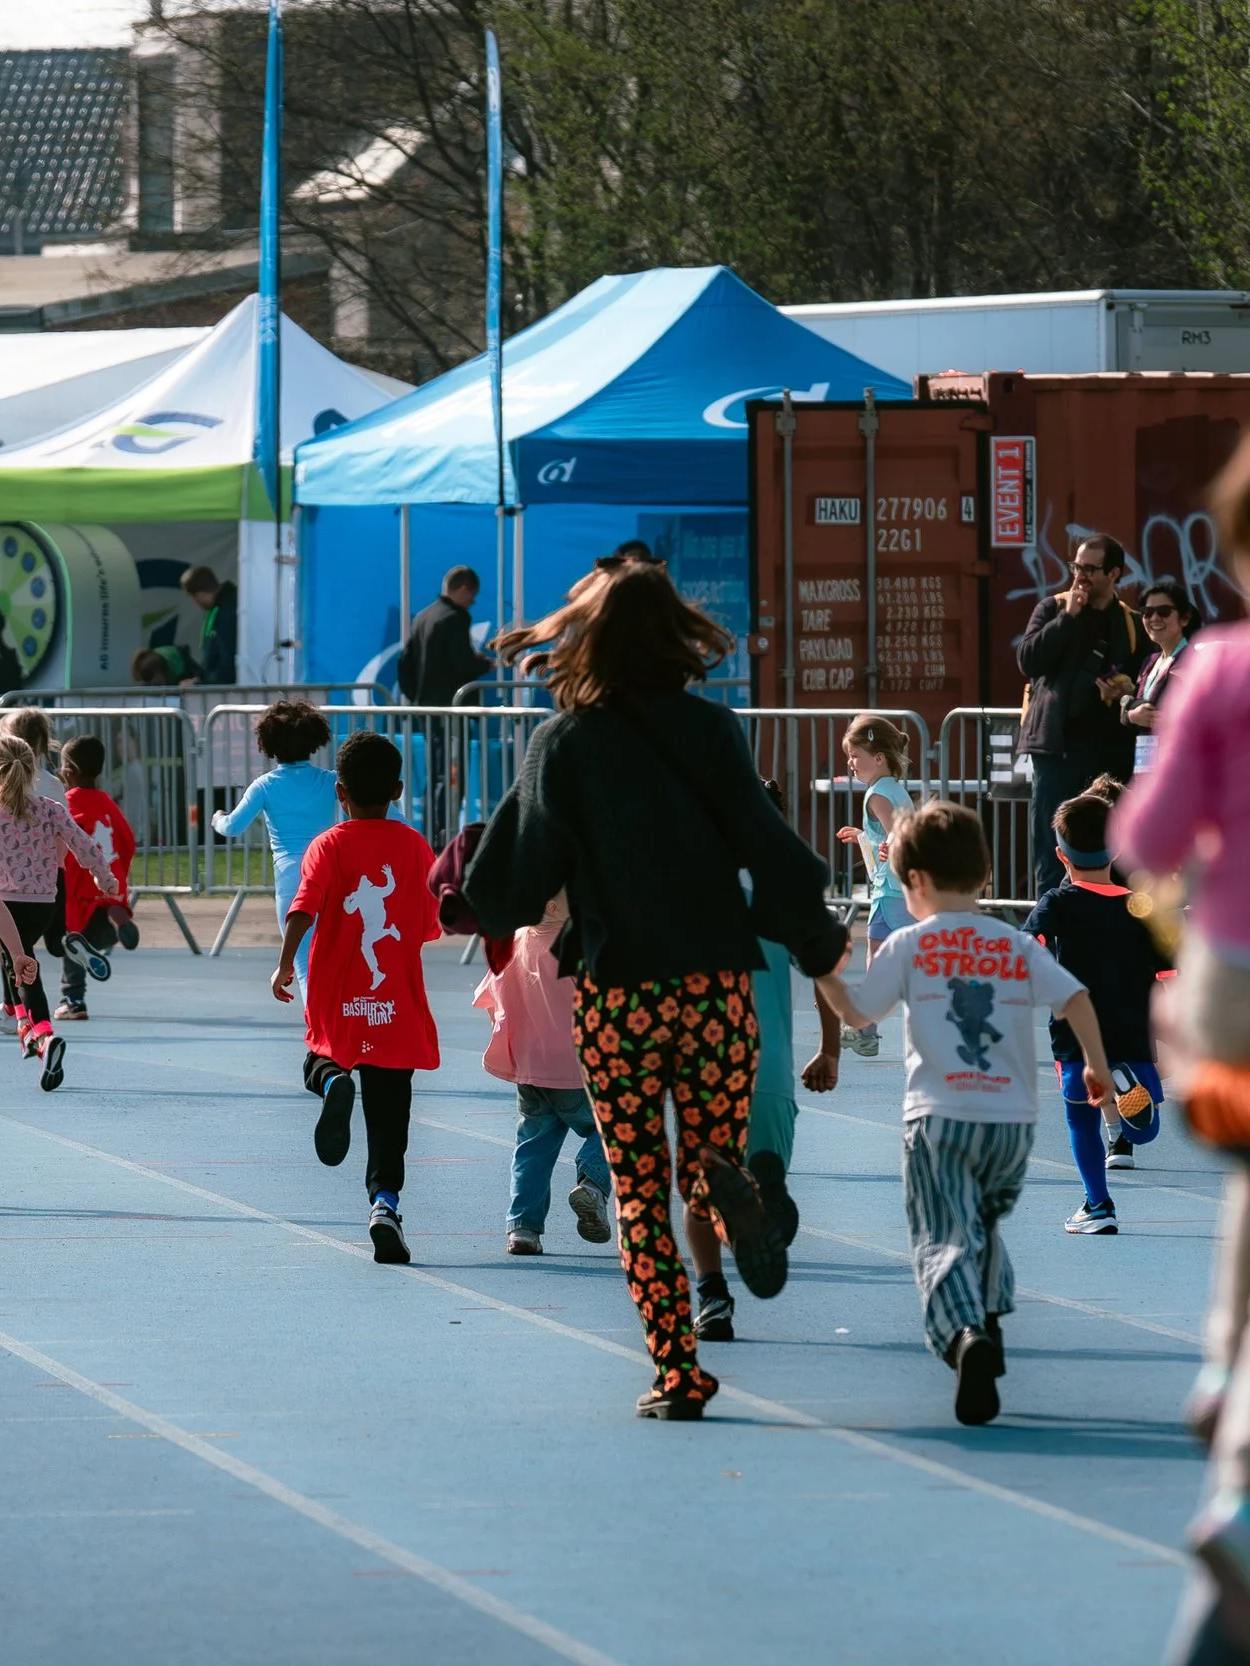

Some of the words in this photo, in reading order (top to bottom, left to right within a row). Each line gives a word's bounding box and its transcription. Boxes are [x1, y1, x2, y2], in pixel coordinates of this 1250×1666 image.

[1181, 330, 1211, 345] RM3
[998, 446, 1021, 458] 1
[817, 499, 858, 521] HAKU
[876, 497, 947, 521] 277906
[963, 497, 973, 519] 4
[997, 466, 1020, 536] EVENT
[876, 528, 922, 552] 22G1
[798, 578, 861, 603] MAXGROSS
[920, 575, 942, 590] KGS
[801, 608, 833, 632] TARE
[923, 605, 945, 620] KGS
[799, 638, 853, 662] PAYLOAD
[918, 926, 976, 951] OUT
[972, 936, 1012, 956] FOR
[924, 951, 1030, 981] STROLL
[367, 1012, 388, 1026] RUN
